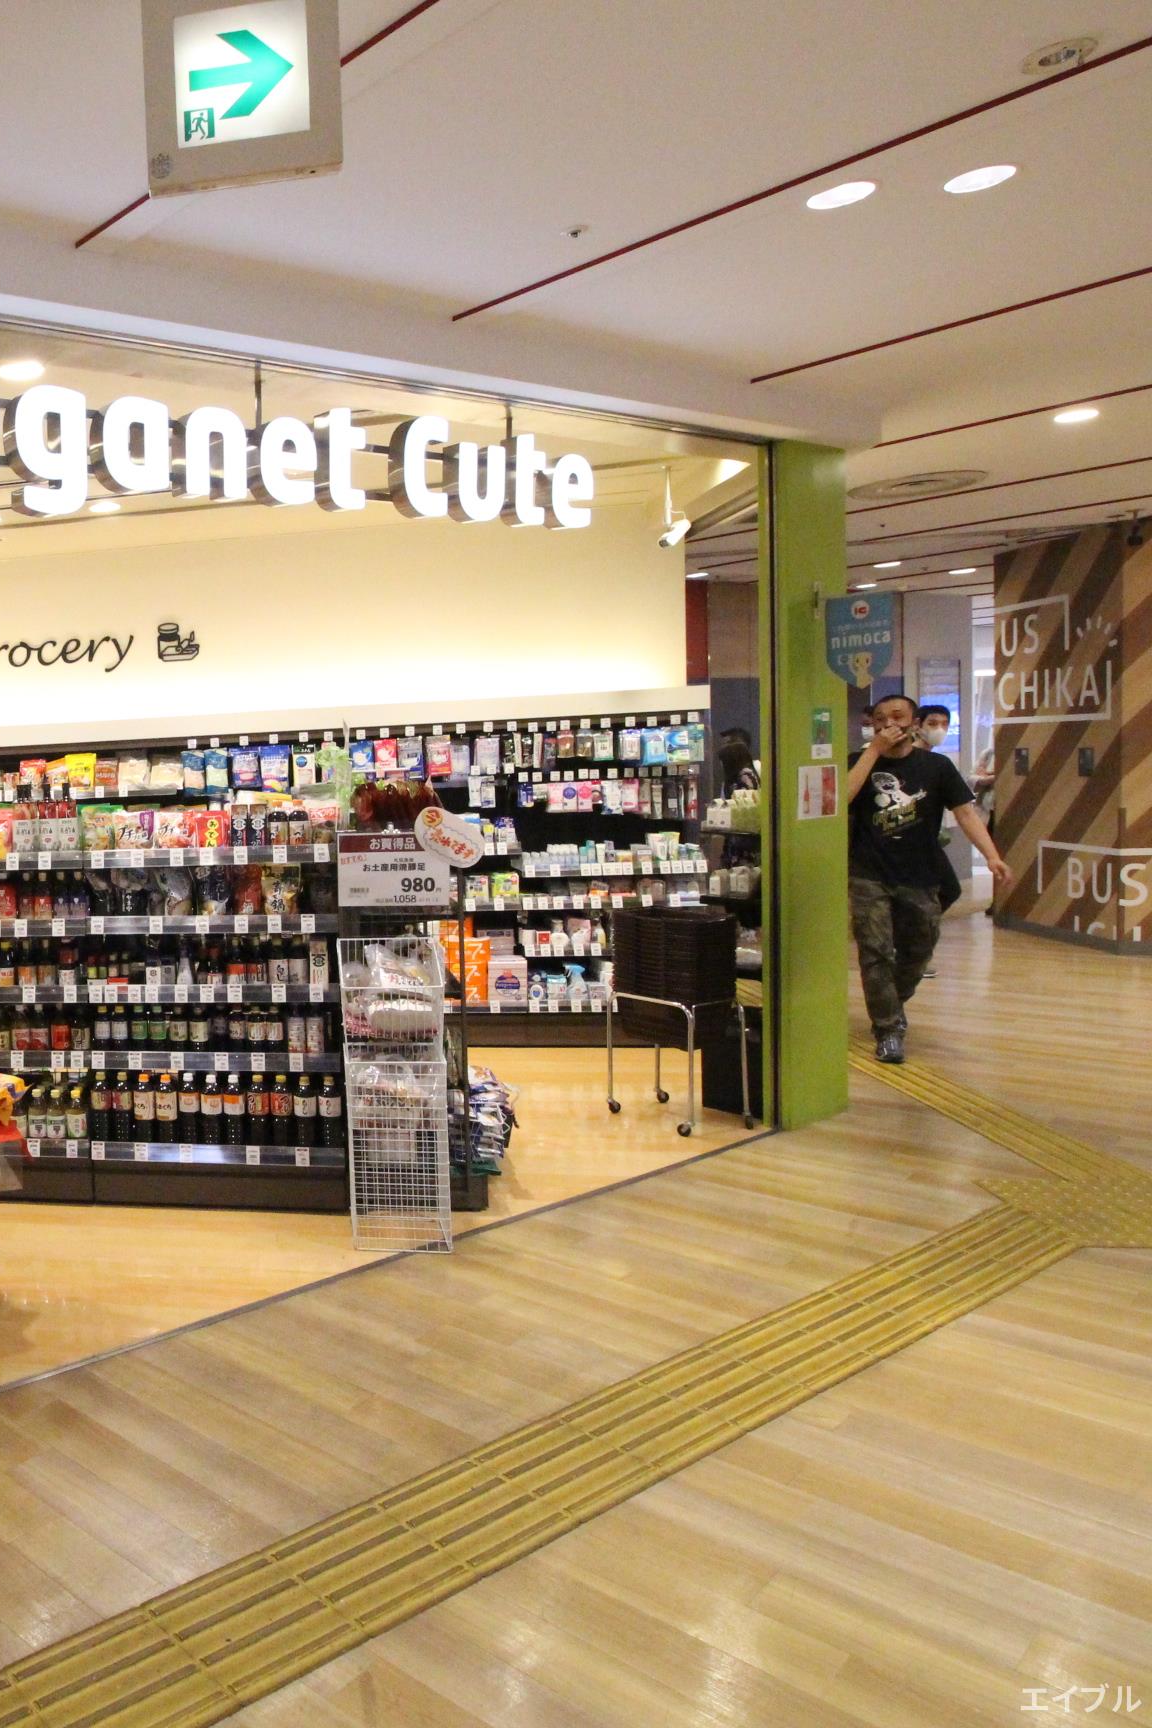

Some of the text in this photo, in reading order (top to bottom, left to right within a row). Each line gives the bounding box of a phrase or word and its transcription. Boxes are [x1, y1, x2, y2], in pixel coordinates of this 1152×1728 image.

[388, 416, 595, 530] Cute
[831, 630, 891, 649] nimoca
[1001, 614, 1040, 658] US
[998, 664, 1101, 711] CHIKA
[369, 837, 416, 850] お買得品
[401, 877, 436, 892] 980
[1067, 856, 1148, 907] BUS
